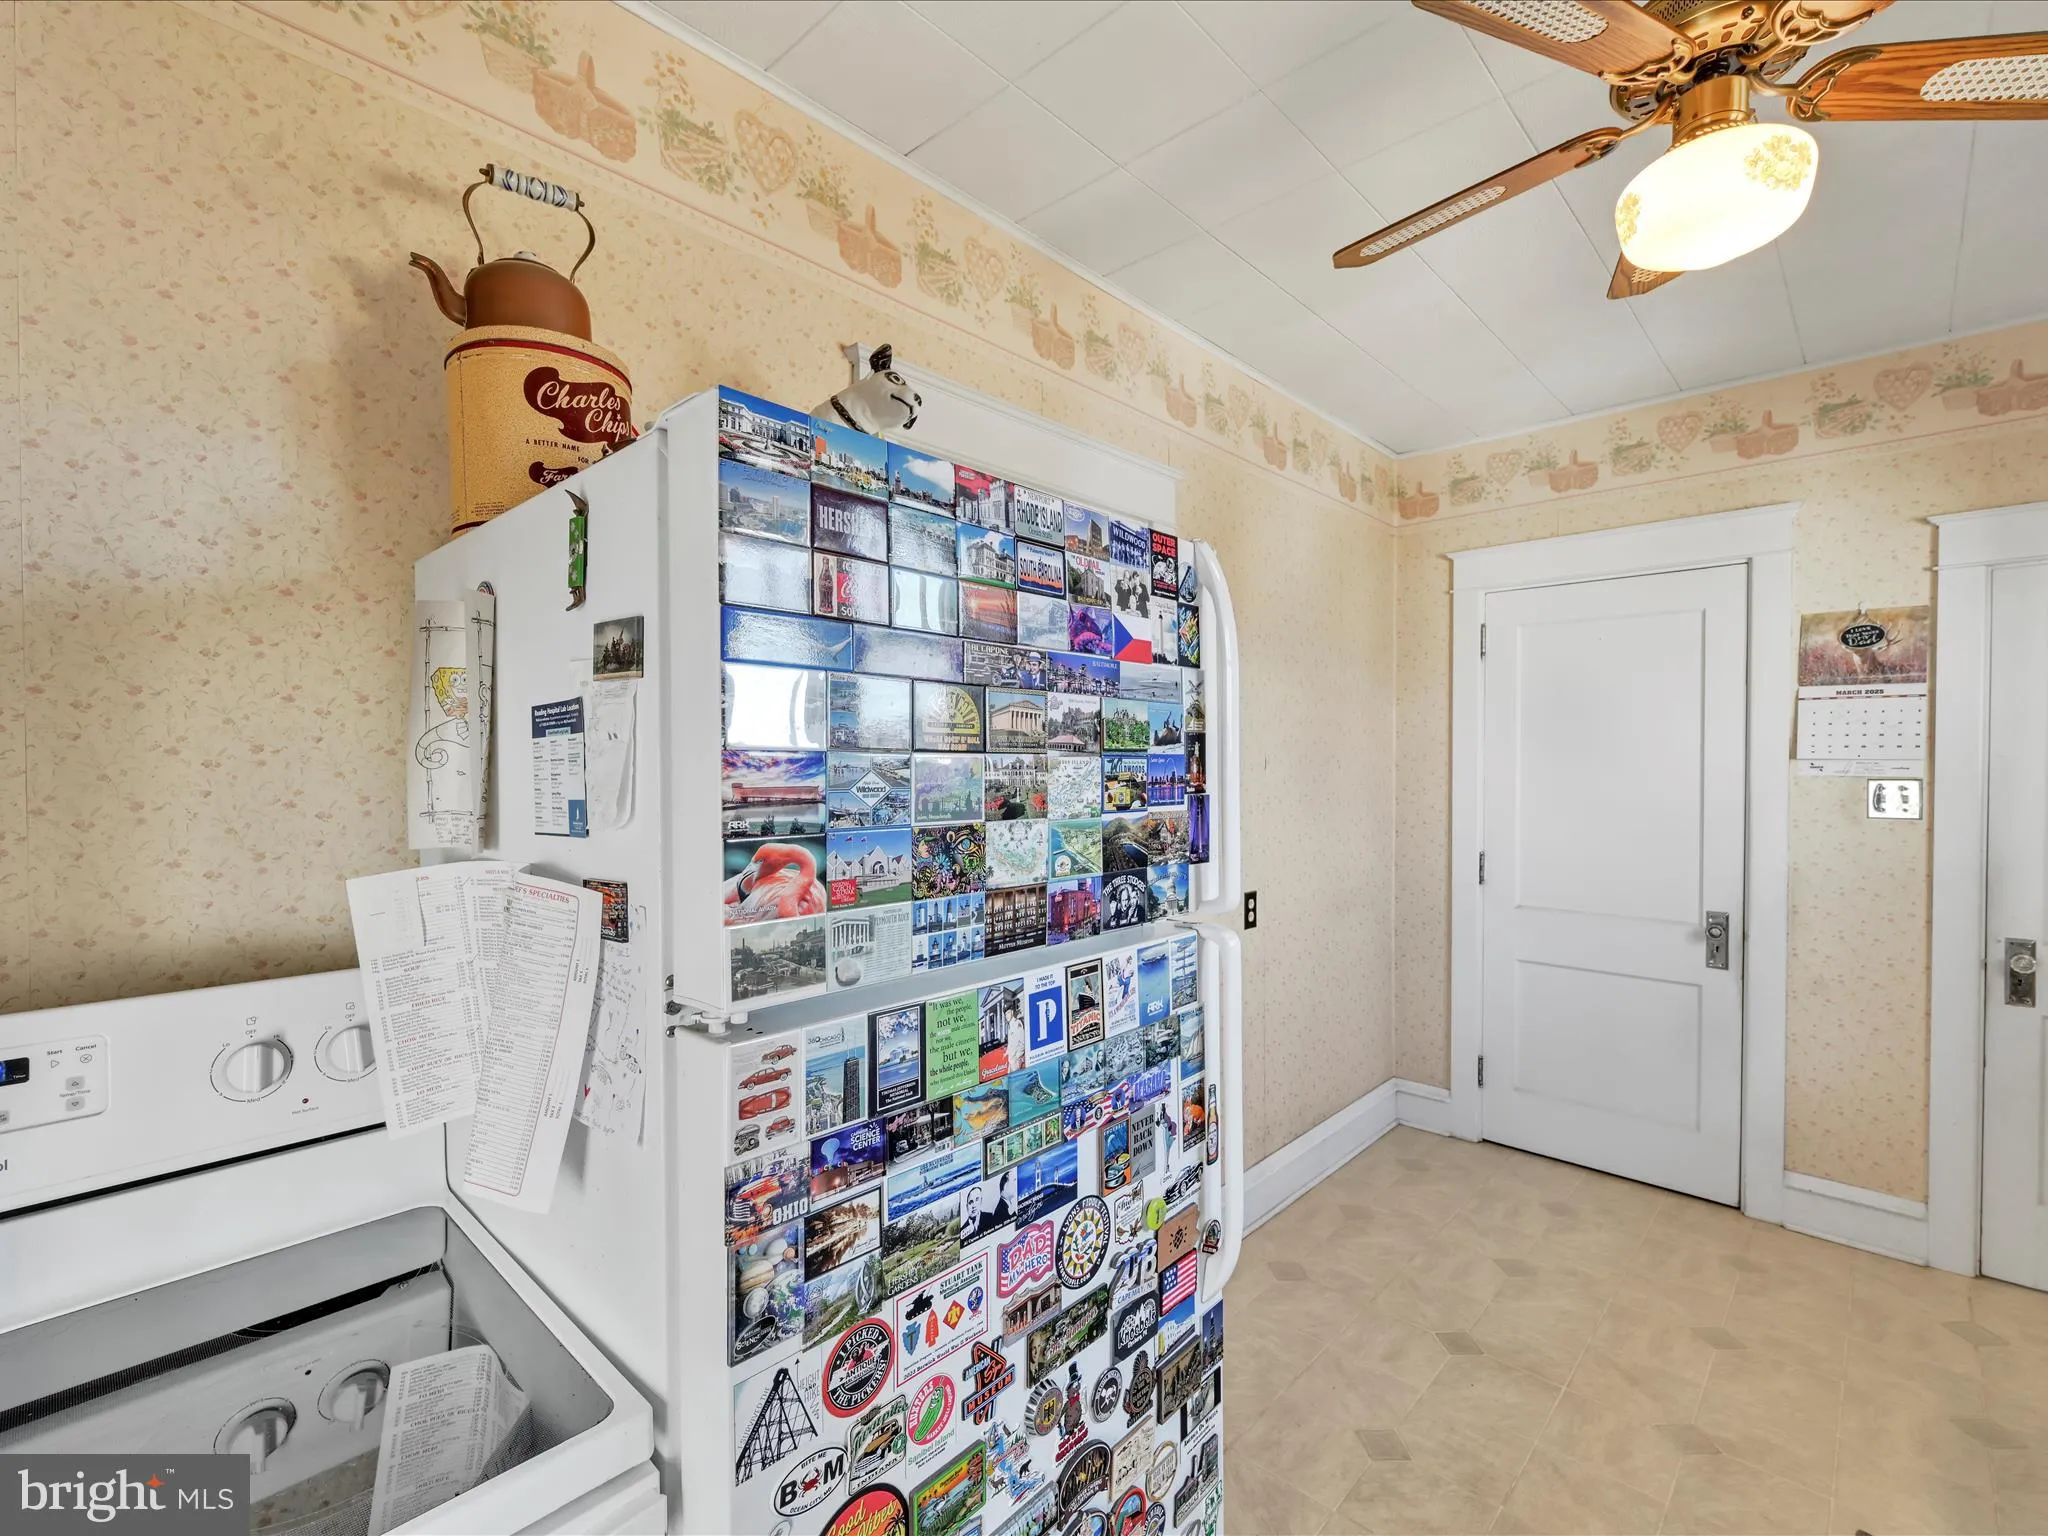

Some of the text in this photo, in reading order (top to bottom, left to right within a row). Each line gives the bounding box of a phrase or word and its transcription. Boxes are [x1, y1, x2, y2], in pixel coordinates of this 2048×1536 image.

[537, 381, 621, 411] Charles
[584, 408, 630, 442] Chips
[534, 439, 559, 448] BETTER
[562, 443, 580, 453] NAME
[577, 456, 589, 464] FOR
[1016, 499, 1063, 533] RHODE ISLAND
[1112, 525, 1146, 549] WILDWOOD
[1152, 532, 1176, 547] OUTER
[1152, 542, 1177, 557] SPACE
[1019, 557, 1037, 577] SOUTH
[971, 644, 1009, 656] AL CAPONE
[856, 784, 887, 794] Wildwood
[728, 820, 750, 830] ARK
[529, 887, 570, 904] SPECIALTIES
[1103, 874, 1147, 896] THE THREE STOOGES
[729, 906, 757, 917] NATIONAL
[1048, 979, 1056, 987] TOP
[952, 998, 964, 1006] we,
[936, 1014, 966, 1029] not we,
[1036, 998, 1057, 1043] P
[1070, 1011, 1101, 1035] TITANIC
[75, 1043, 97, 1052] Cancel
[929, 1042, 955, 1054] the male
[942, 1048, 973, 1063] but we,
[929, 1063, 953, 1077] the whole
[981, 1062, 1008, 1079] Graceland
[1131, 1115, 1155, 1132] NEVER
[850, 1127, 881, 1145] SCIENCE
[852, 1136, 881, 1151] CENTER
[1133, 1127, 1153, 1144] BACK
[1132, 1138, 1154, 1158] DOWN
[772, 1197, 808, 1226] OHIO
[1062, 1199, 1109, 1245] LYONS FIDDLE FESTIVAL
[1009, 1230, 1049, 1269] DAD
[939, 1261, 983, 1289] STUART TANK
[1008, 1254, 1048, 1286] MY HERO
[887, 1276, 919, 1296] GARDENS
[1117, 1282, 1153, 1304] CAPE MAY, NJ
[846, 1327, 880, 1349] PICKED
[1117, 1311, 1156, 1349] Knoebels
[904, 1328, 984, 1381] 2023 Berwick World War Weekend
[846, 1358, 877, 1378] ANTIQUE
[965, 1356, 991, 1380] AMERICAN
[805, 1383, 817, 1393] AND
[833, 1360, 887, 1406] THE PICKERS!
[967, 1372, 1013, 1412] MUSEUM
[742, 1386, 770, 1446] SURVIVED THE
[909, 1383, 934, 1428] HUXTERS
[908, 1444, 934, 1466] Sanibel
[934, 1428, 955, 1449] Island
[801, 1452, 827, 1470] BITE ME
[823, 1454, 844, 1485] M
[857, 1457, 898, 1489] INDIANA
[779, 1480, 798, 1509] B
[789, 1486, 832, 1514] OCEAN CITY, MD
[827, 1499, 866, 1536] Good
[857, 1500, 897, 1536] Vibes
